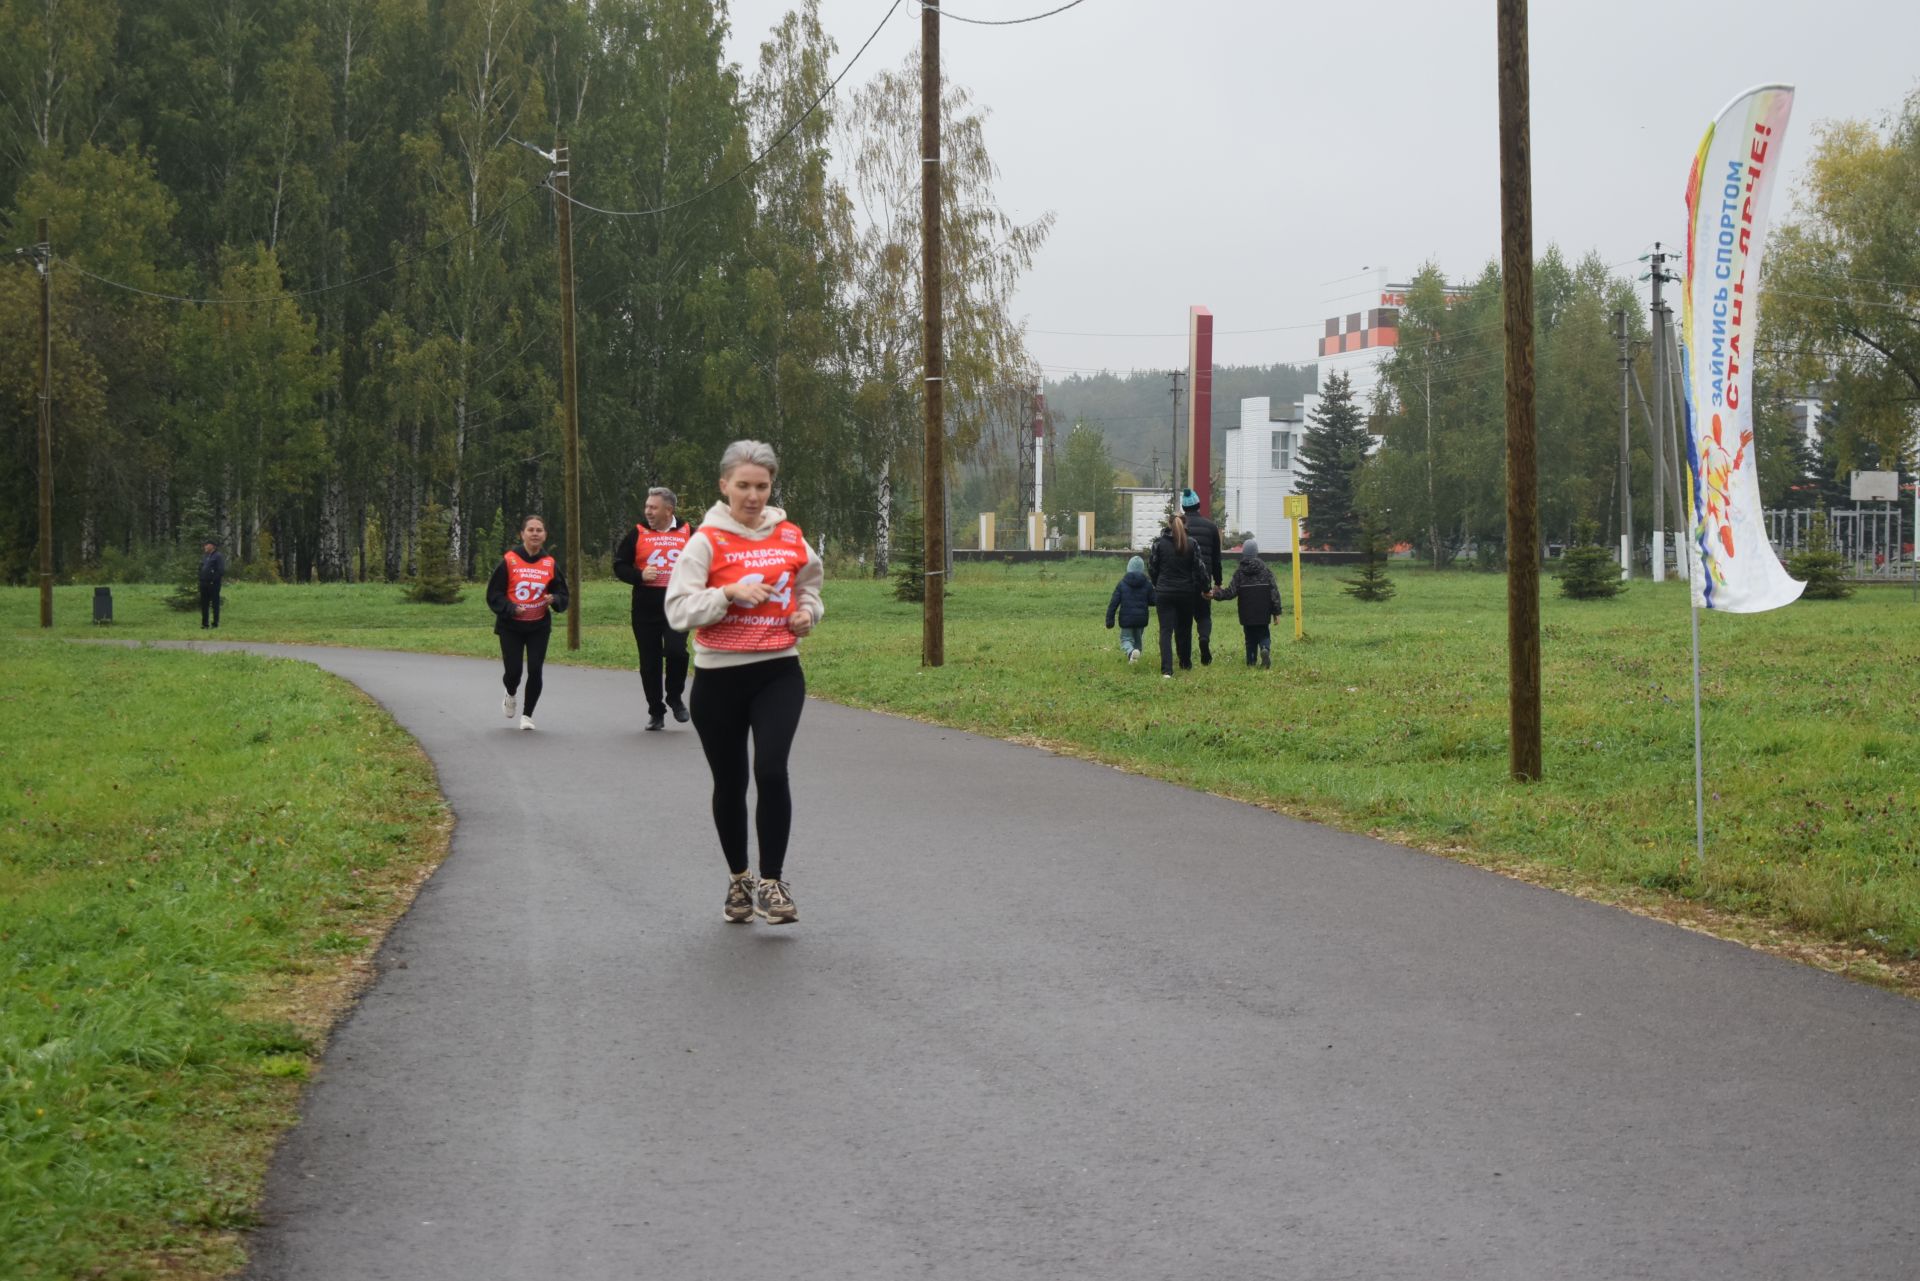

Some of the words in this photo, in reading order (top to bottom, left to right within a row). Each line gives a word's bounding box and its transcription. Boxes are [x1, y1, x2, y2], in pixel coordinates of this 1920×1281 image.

[1715, 160, 1743, 280] СПОРТОМ
[1739, 123, 1771, 257] ЯРЧЕ!
[1709, 288, 1728, 407] ЗАЙМИСЬ
[725, 548, 797, 562] ТУКАЕВСКИЙ
[744, 557, 786, 568] РАЙОН
[515, 581, 546, 601] 67
